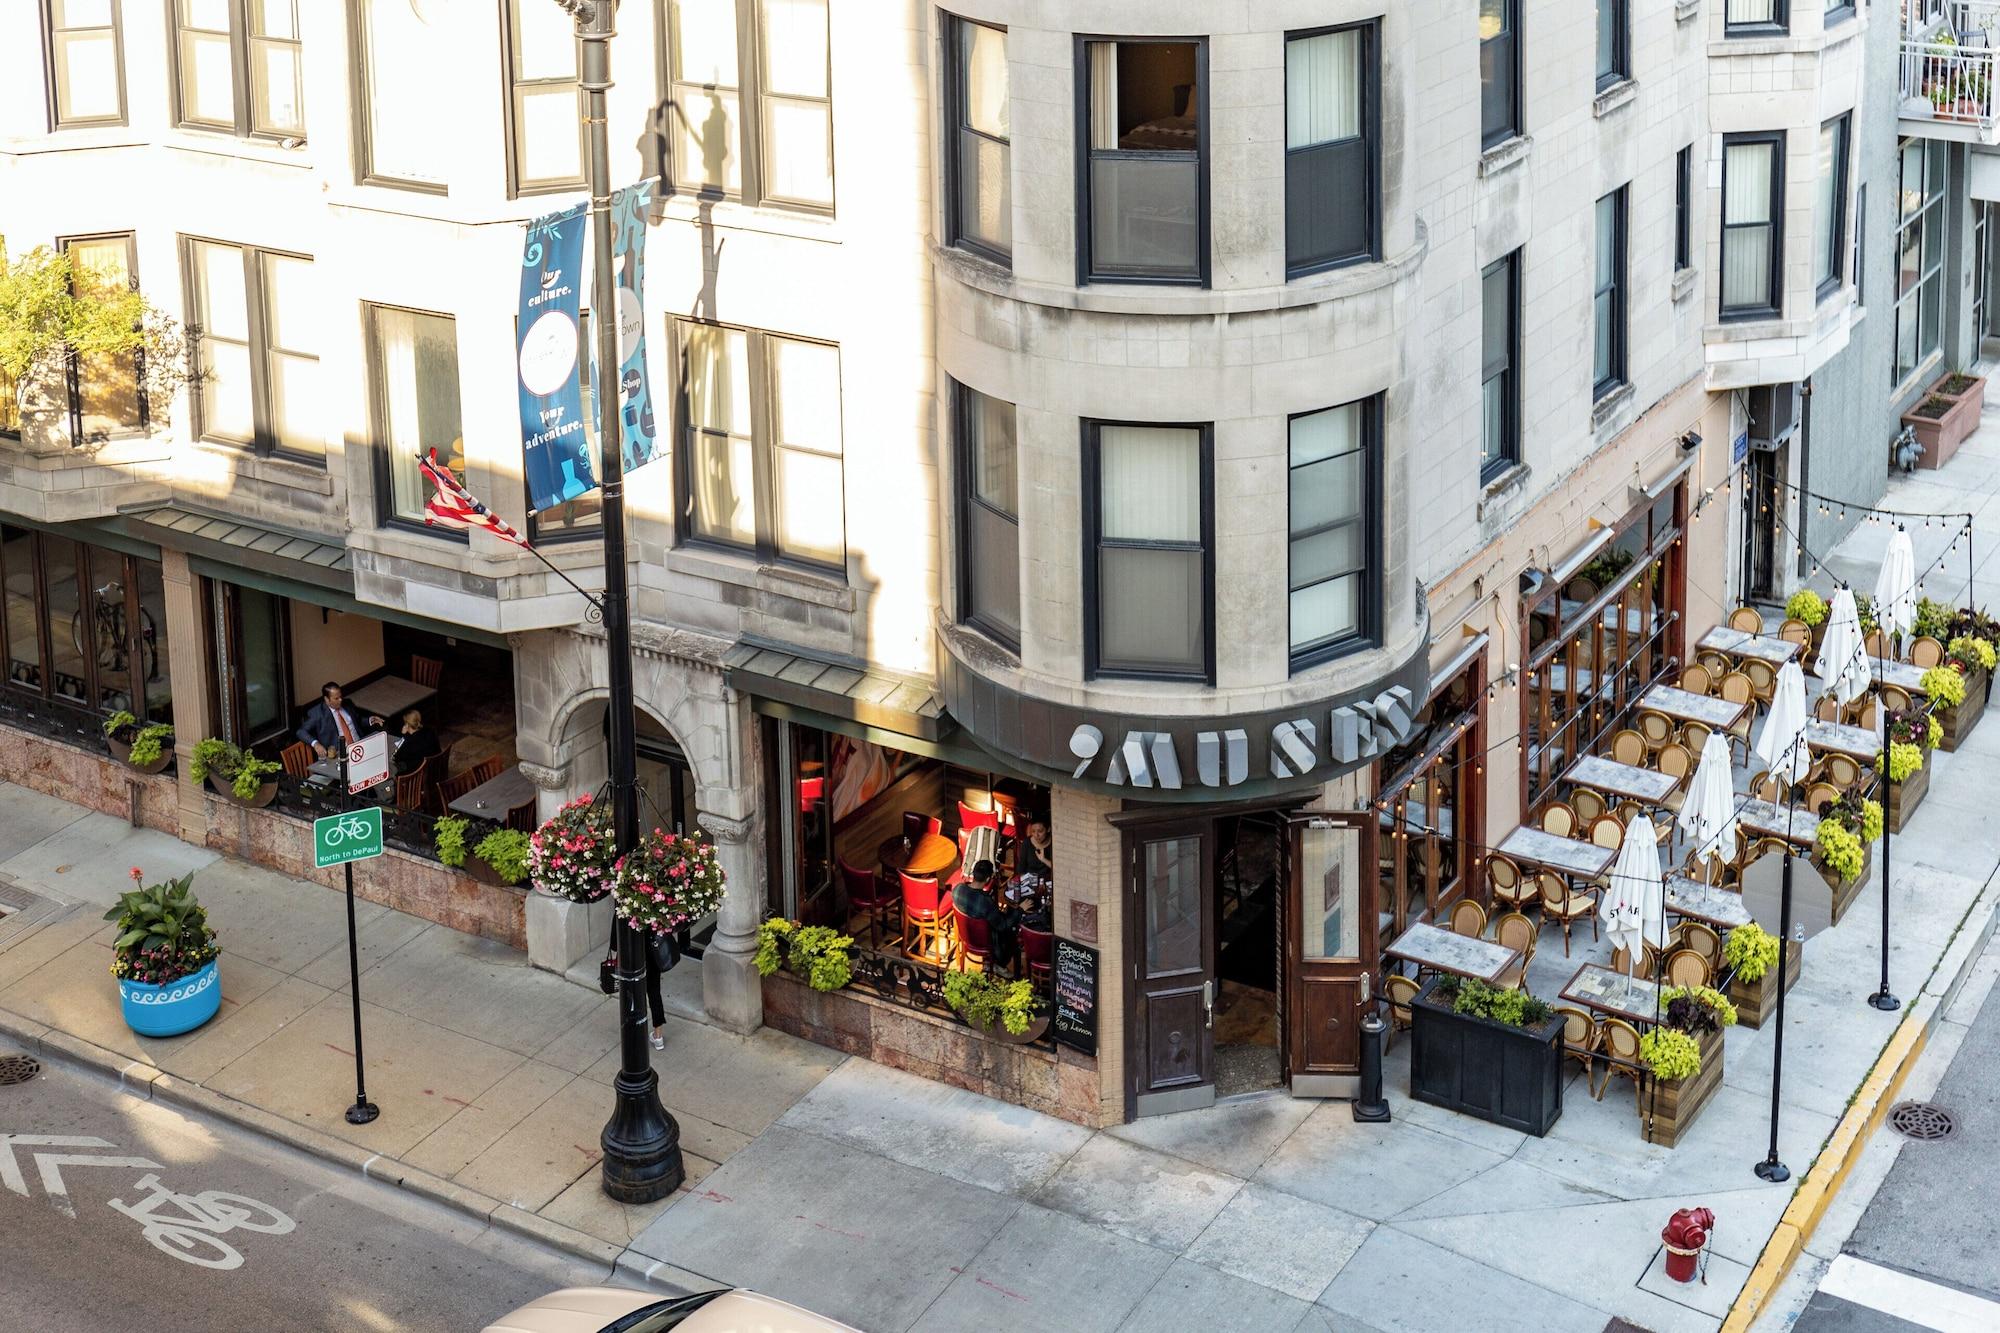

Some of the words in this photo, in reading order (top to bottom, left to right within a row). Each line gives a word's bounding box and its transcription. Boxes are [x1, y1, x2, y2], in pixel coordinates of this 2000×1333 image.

[527, 285, 572, 308] culture.
[539, 406, 565, 424] Your
[525, 420, 583, 450] adventure.
[352, 782, 365, 792] TOW
[369, 774, 385, 786] ZONE
[319, 853, 341, 863] North
[352, 845, 379, 856] DePaul
[1056, 1014, 1068, 1031] Egg
[1070, 1020, 1093, 1036] Lemon
